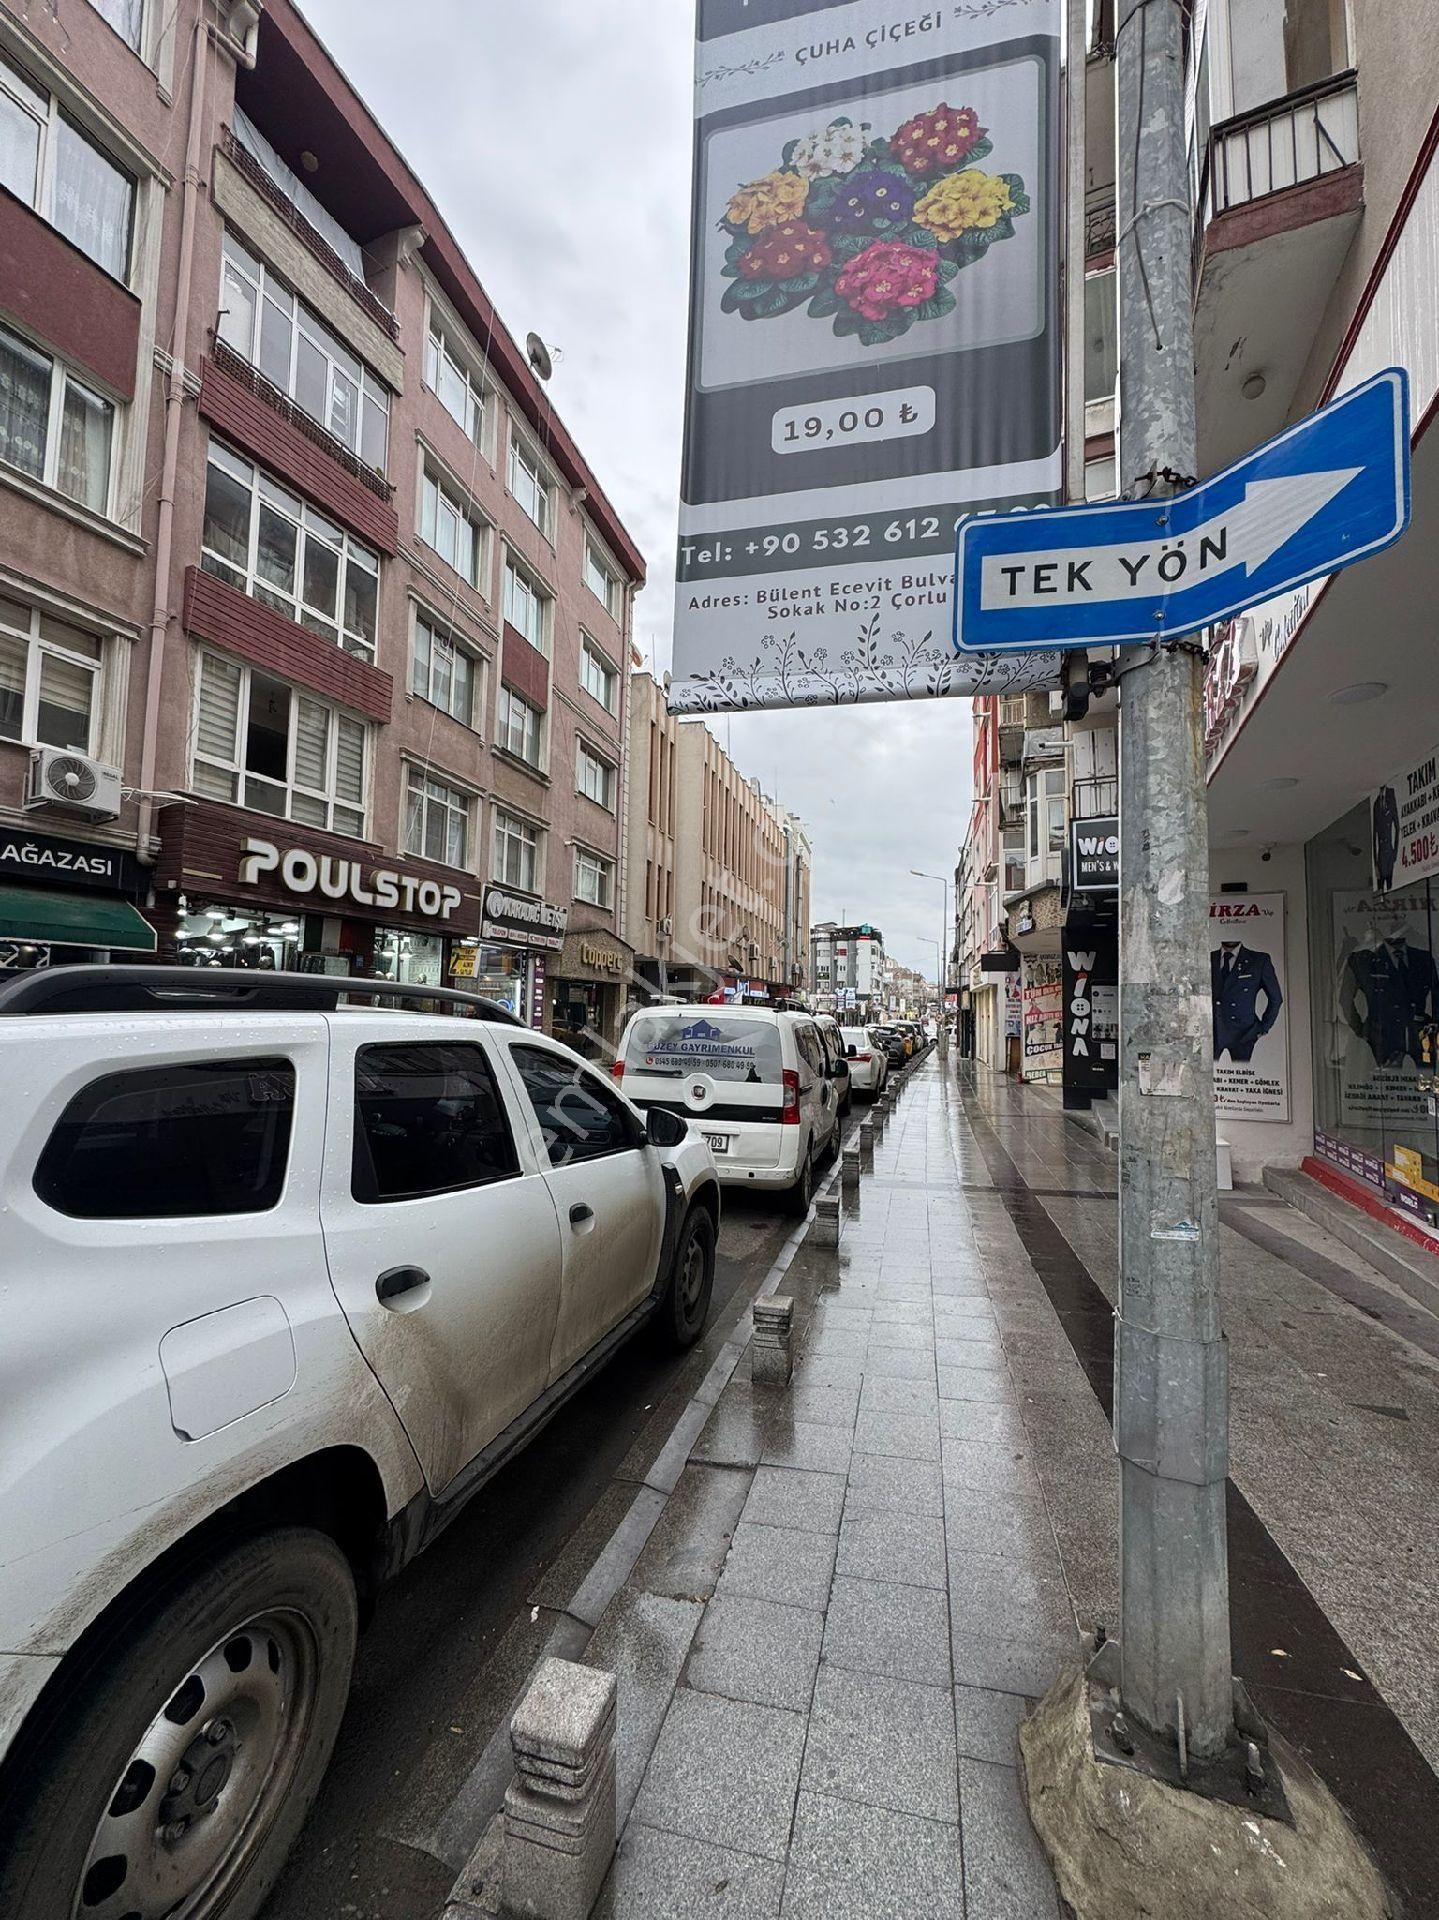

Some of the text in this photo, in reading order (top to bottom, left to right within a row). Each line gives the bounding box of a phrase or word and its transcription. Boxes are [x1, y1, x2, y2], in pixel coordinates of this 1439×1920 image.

[795, 11, 943, 66] ÇUHA ÇİÇEĞİ
[783, 405, 885, 442] 19,00
[681, 541, 733, 566] Tel:
[745, 532, 801, 558] +90
[812, 524, 871, 551] 532
[883, 515, 940, 544] 612
[1000, 526, 1228, 597] TEK YÖN
[688, 591, 749, 611] Adres:
[756, 582, 822, 605] Bülent
[830, 576, 893, 597] Ecevit
[767, 590, 947, 620] Sokak No:2 Çorlu
[1406, 757, 1436, 796] TAKIM
[237, 836, 462, 919] POULSTOP
